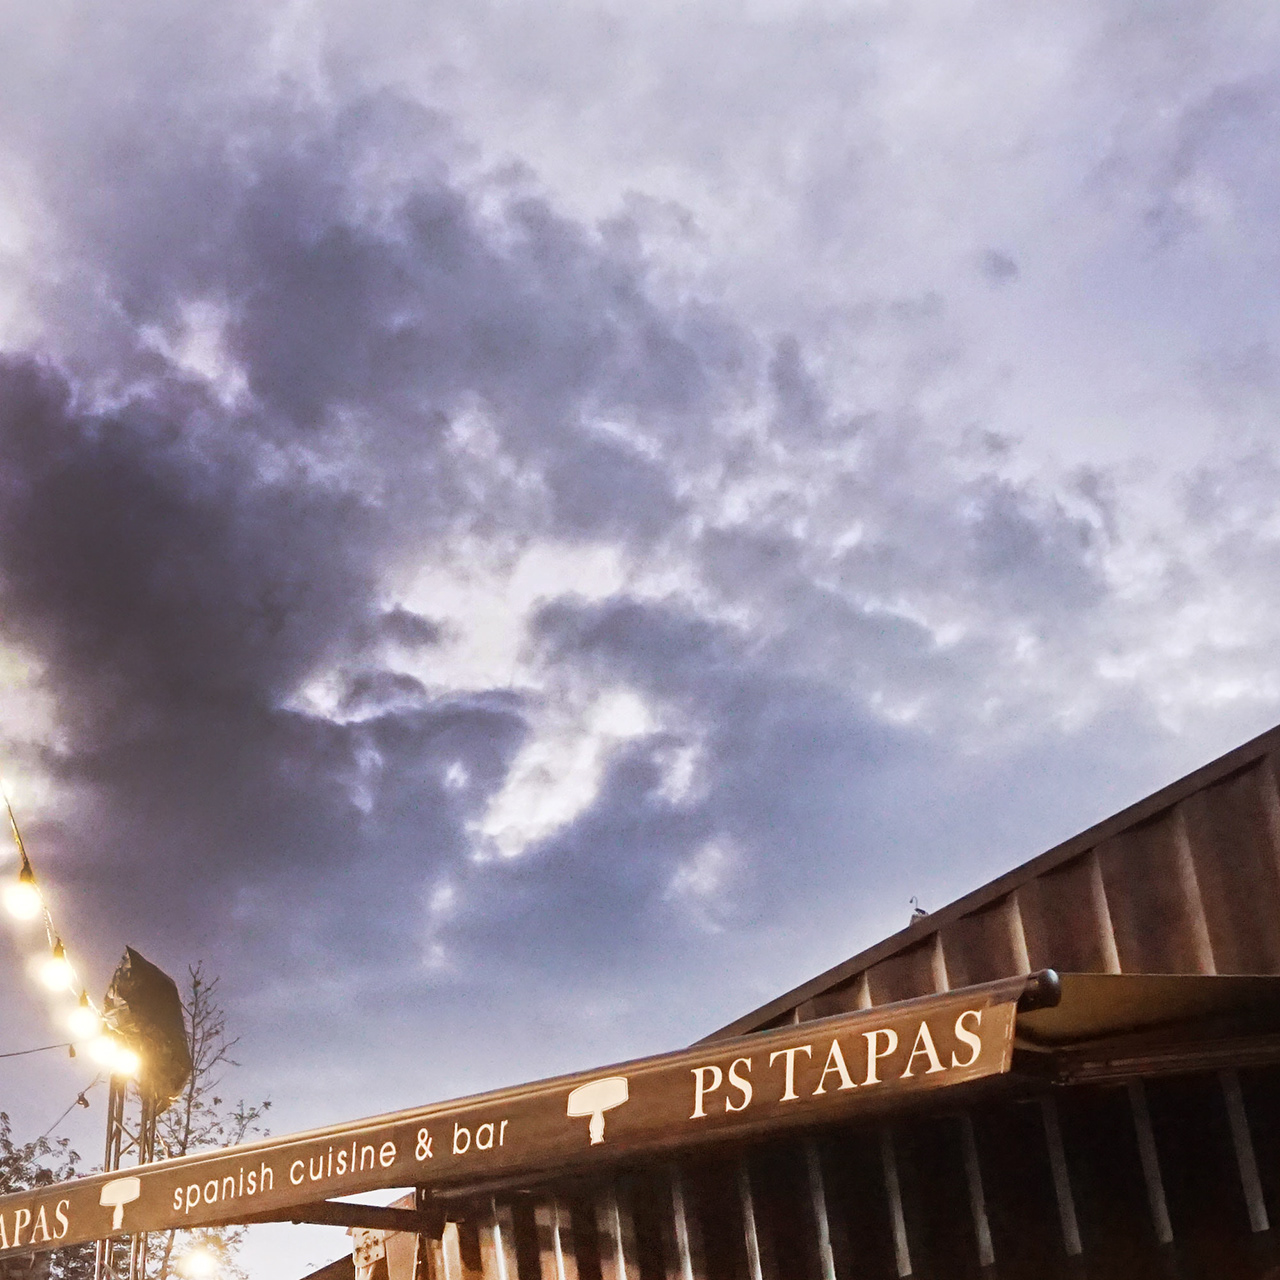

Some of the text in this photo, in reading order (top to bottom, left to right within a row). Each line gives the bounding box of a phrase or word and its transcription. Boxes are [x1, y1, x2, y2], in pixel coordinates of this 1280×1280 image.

[173, 1161, 274, 1214] spanish
[415, 1127, 434, 1161] &
[452, 1118, 510, 1156] bar
